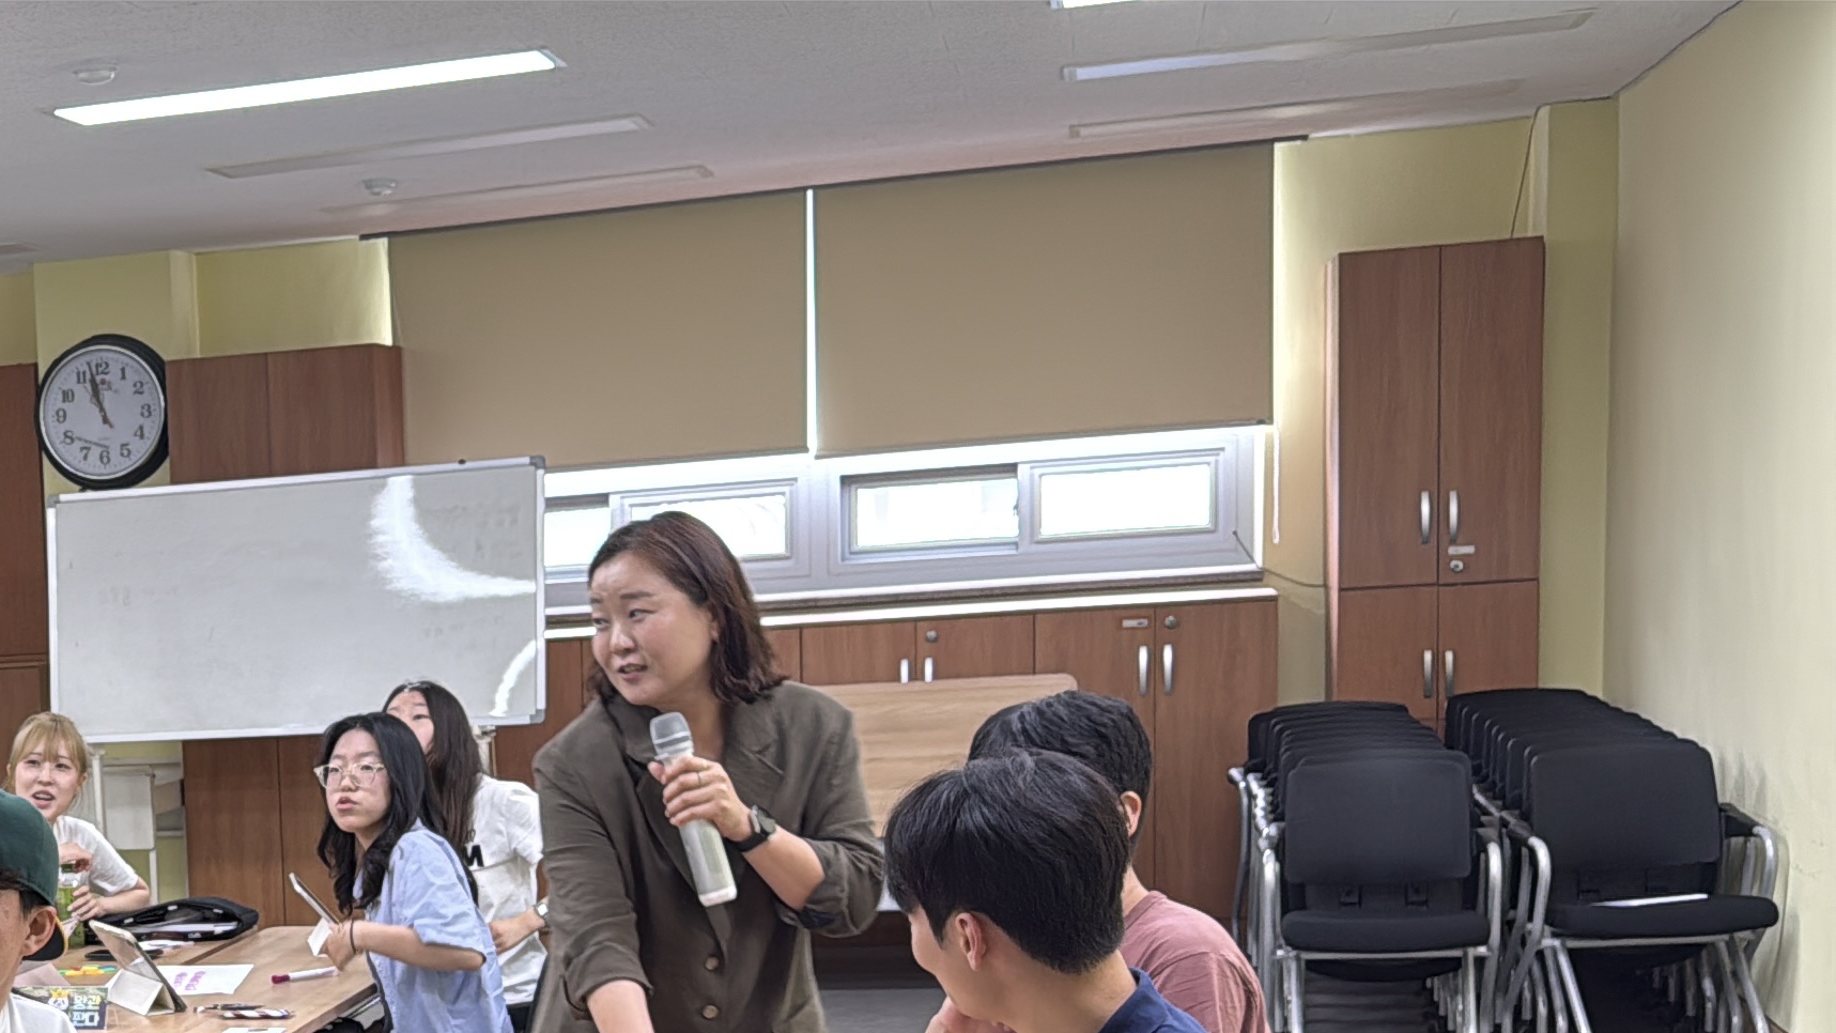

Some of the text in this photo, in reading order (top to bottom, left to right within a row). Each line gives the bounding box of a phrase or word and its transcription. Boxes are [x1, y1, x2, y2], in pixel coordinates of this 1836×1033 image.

[94, 361, 110, 376] 12
[120, 366, 127, 380] 1
[76, 369, 86, 384] 11
[133, 380, 145, 395] 2
[61, 388, 75, 404] 10
[55, 407, 67, 424] 9
[140, 403, 152, 418] 3
[63, 430, 75, 446] 8
[133, 425, 145, 440] 4
[79, 446, 92, 461] 7
[98, 449, 111, 465] 6
[120, 443, 131, 458] 5
